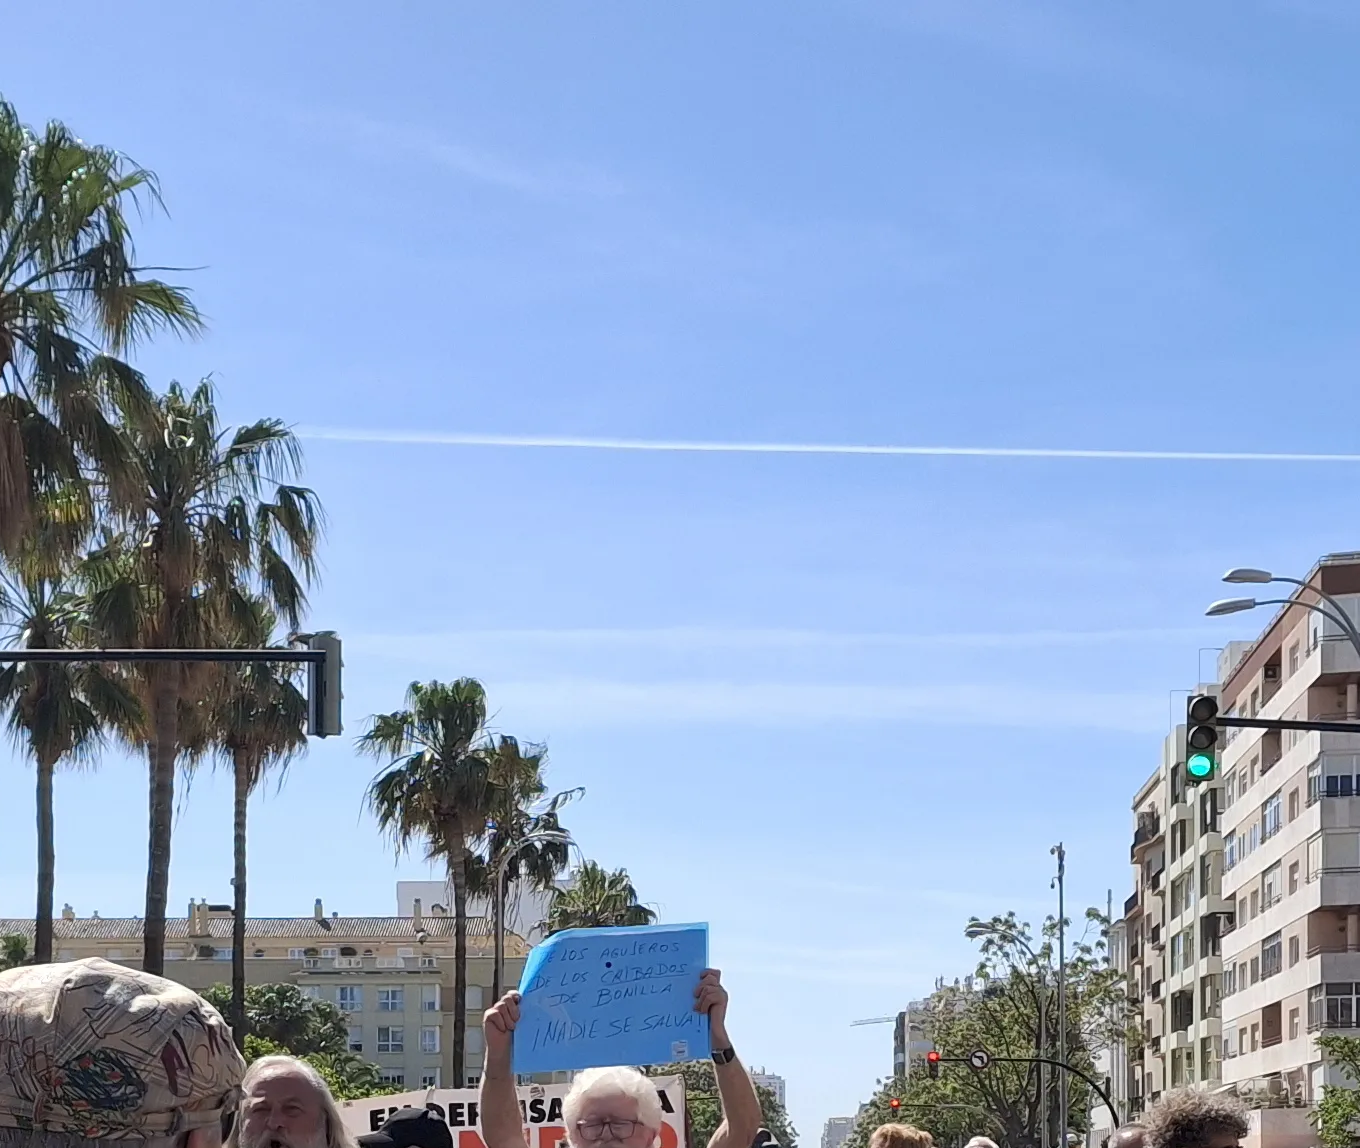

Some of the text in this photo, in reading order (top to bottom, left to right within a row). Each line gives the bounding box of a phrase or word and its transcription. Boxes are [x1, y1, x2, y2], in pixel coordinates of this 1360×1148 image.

[560, 948, 589, 962] LOS
[600, 941, 680, 959] AGUJEROS
[528, 973, 552, 993] DE
[560, 971, 589, 987] LOS
[547, 983, 674, 1008] DE BONILLA
[605, 1016, 634, 1038] SE
[638, 1012, 702, 1034] SALVA!
